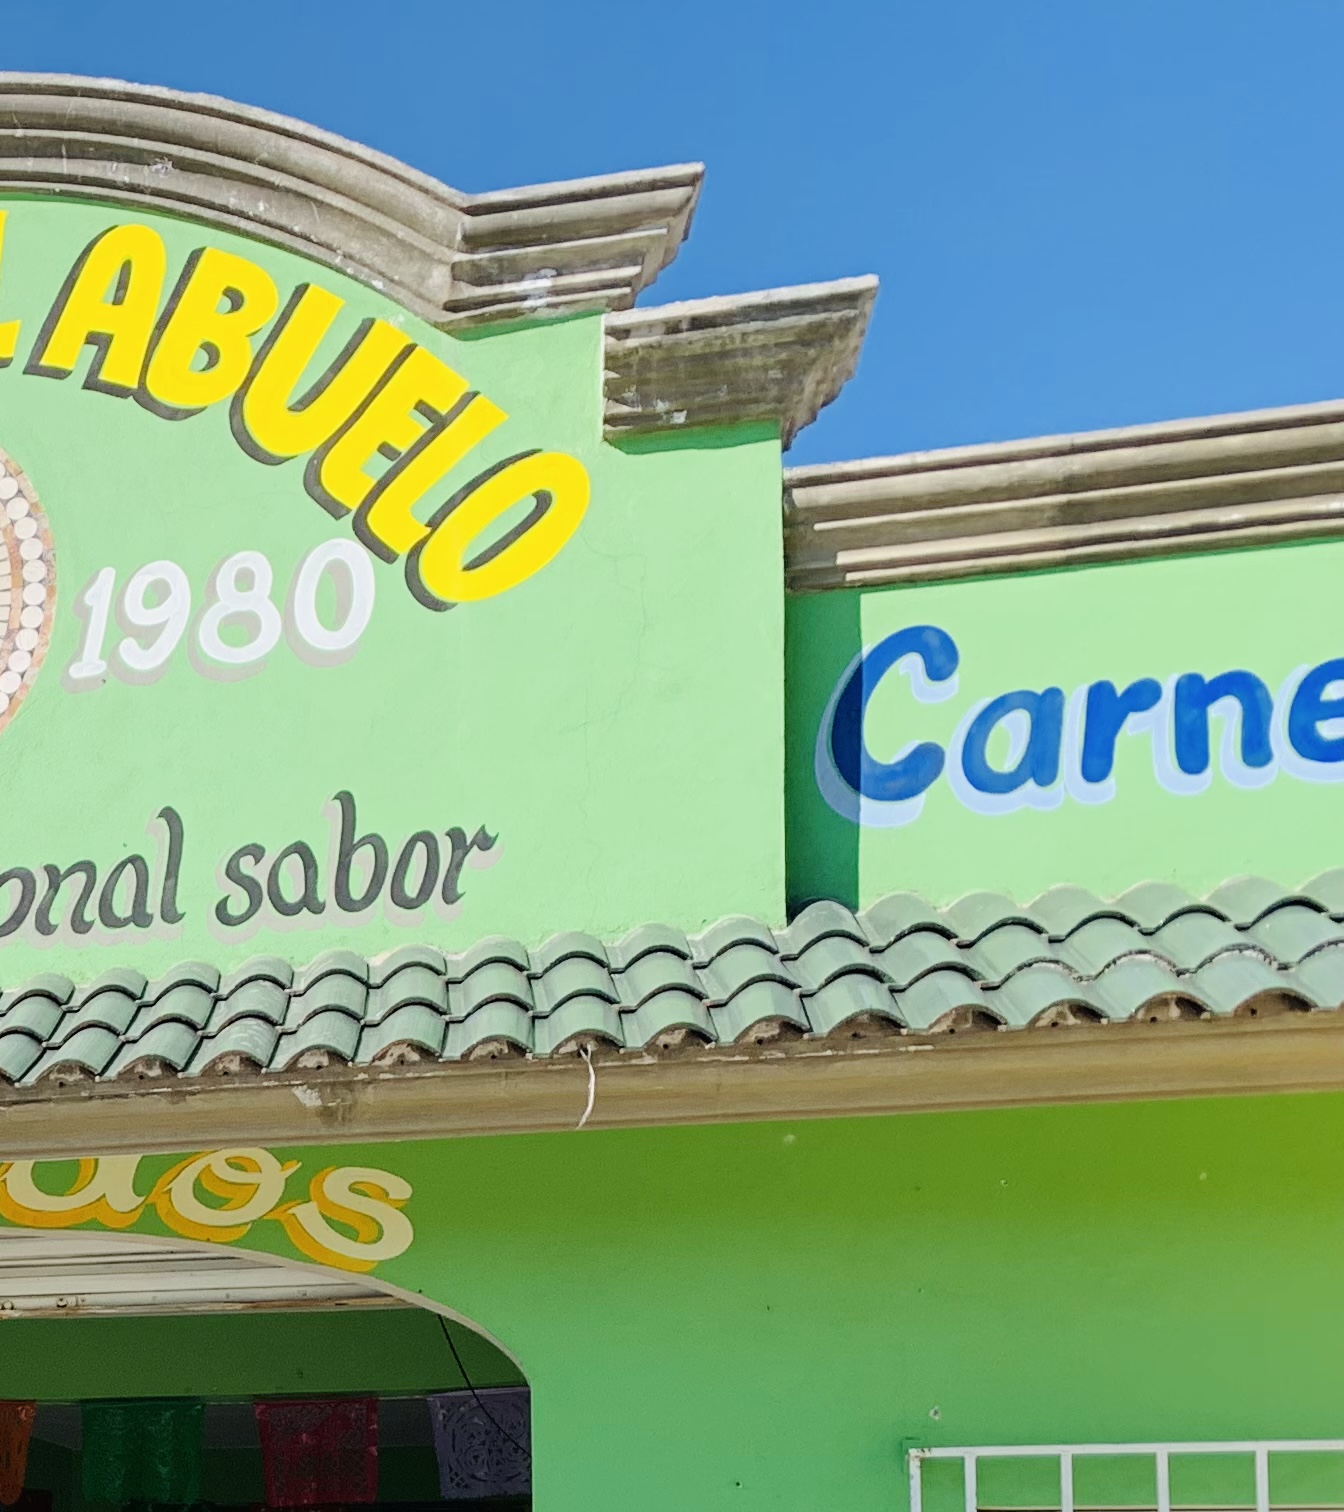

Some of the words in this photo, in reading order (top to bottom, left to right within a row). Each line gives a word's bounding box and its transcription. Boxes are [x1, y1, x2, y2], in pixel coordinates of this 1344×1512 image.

[23, 223, 590, 611] ABUELO
[64, 538, 376, 690] 1980
[214, 789, 500, 928] sabor
